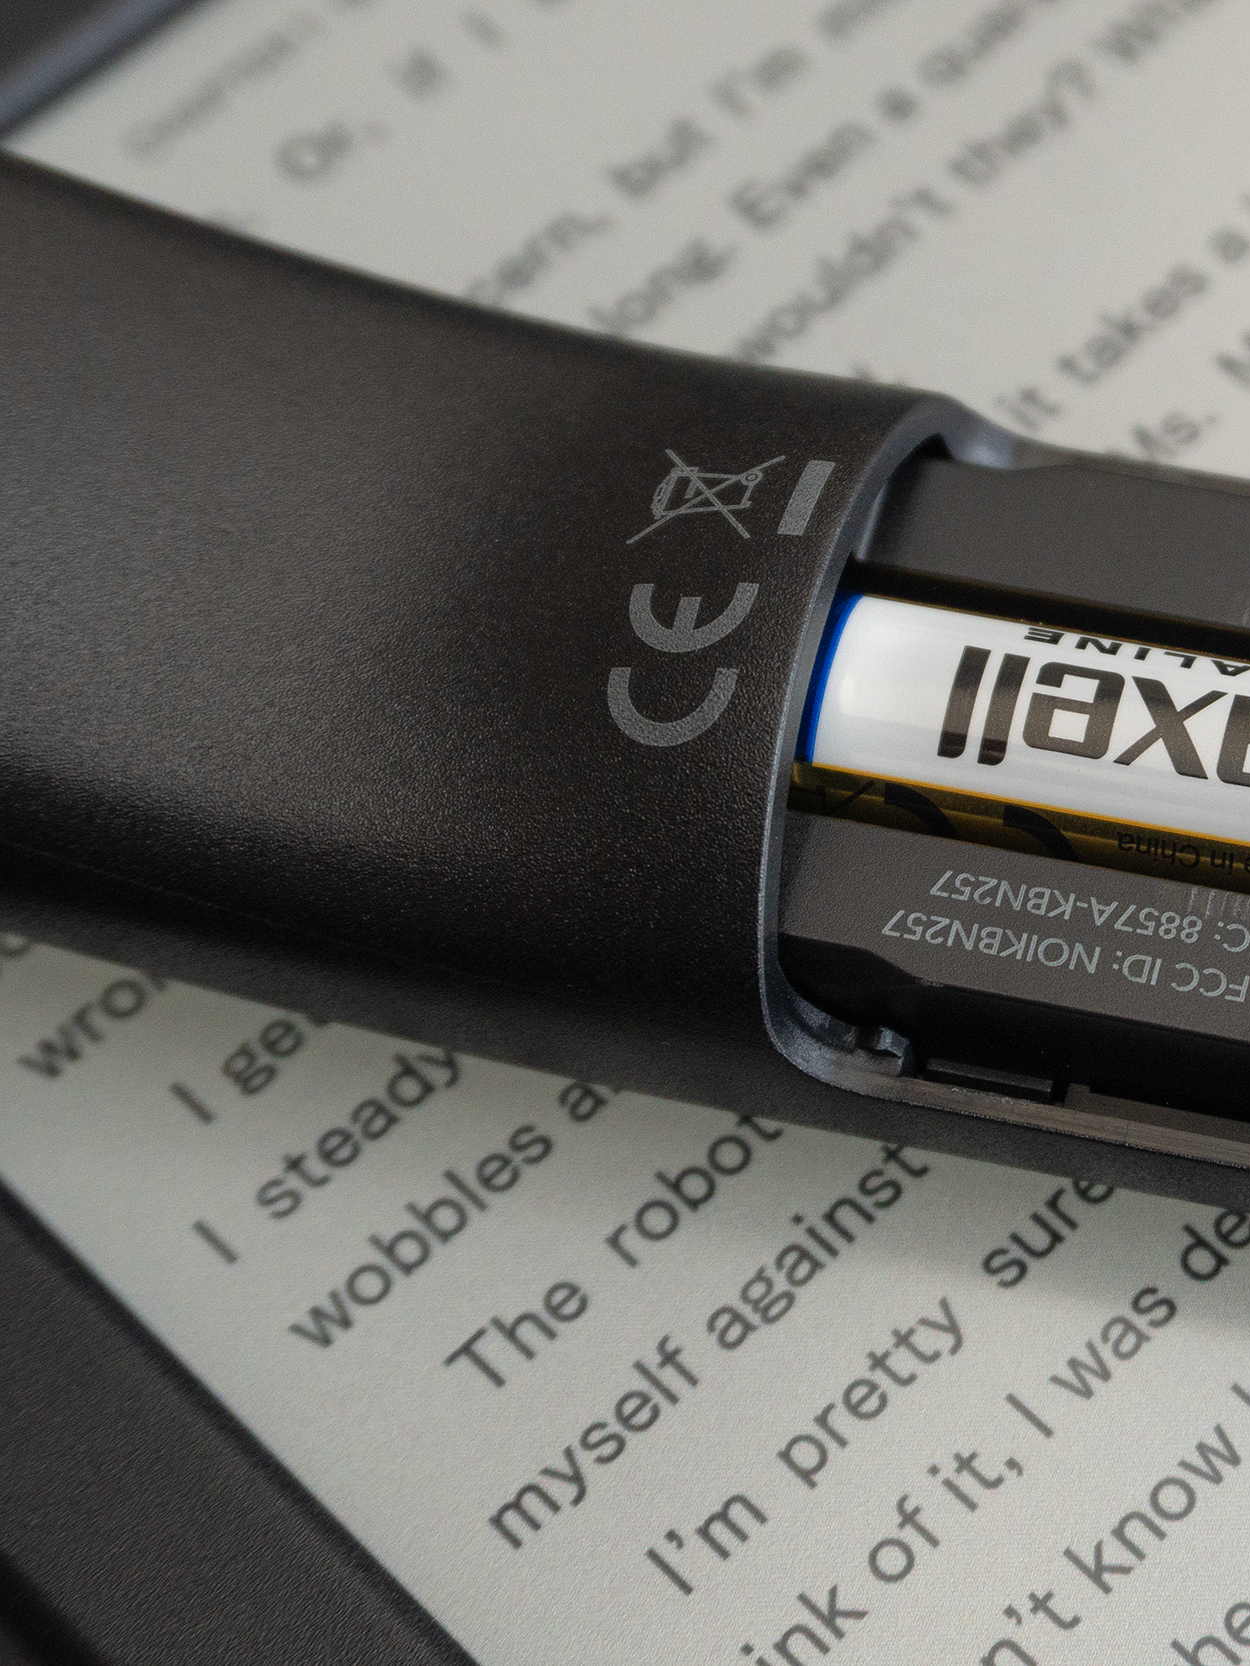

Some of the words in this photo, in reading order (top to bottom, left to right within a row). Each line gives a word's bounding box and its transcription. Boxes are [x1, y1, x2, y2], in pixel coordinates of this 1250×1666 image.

[604, 115, 714, 202] but
[726, 119, 877, 233] Even
[876, 86, 922, 124] a
[945, 55, 1097, 188] they?
[1054, 263, 1210, 386] takes
[929, 869, 1203, 944] 8857A-KBN257
[1115, 830, 1202, 870] China
[1209, 850, 1234, 877] in
[17, 973, 169, 1084] wro
[1112, 949, 1163, 985] ID:
[1171, 961, 1250, 1003] FCC
[167, 1079, 218, 1126] I
[190, 1216, 241, 1266] I
[253, 1045, 465, 1221] steady
[287, 1122, 556, 1351] wobbles
[443, 1278, 590, 1391] The
[604, 1113, 785, 1270] robot
[487, 1334, 700, 1551] myself
[705, 1142, 931, 1352] against
[644, 1492, 769, 1597] I'm
[775, 1295, 966, 1490] pretty
[981, 1176, 1116, 1290] sure
[866, 1495, 942, 1586] of
[926, 1448, 1025, 1515] it,
[1003, 1391, 1056, 1440] I
[1048, 1282, 1179, 1402] was
[1062, 1424, 1244, 1596] know
